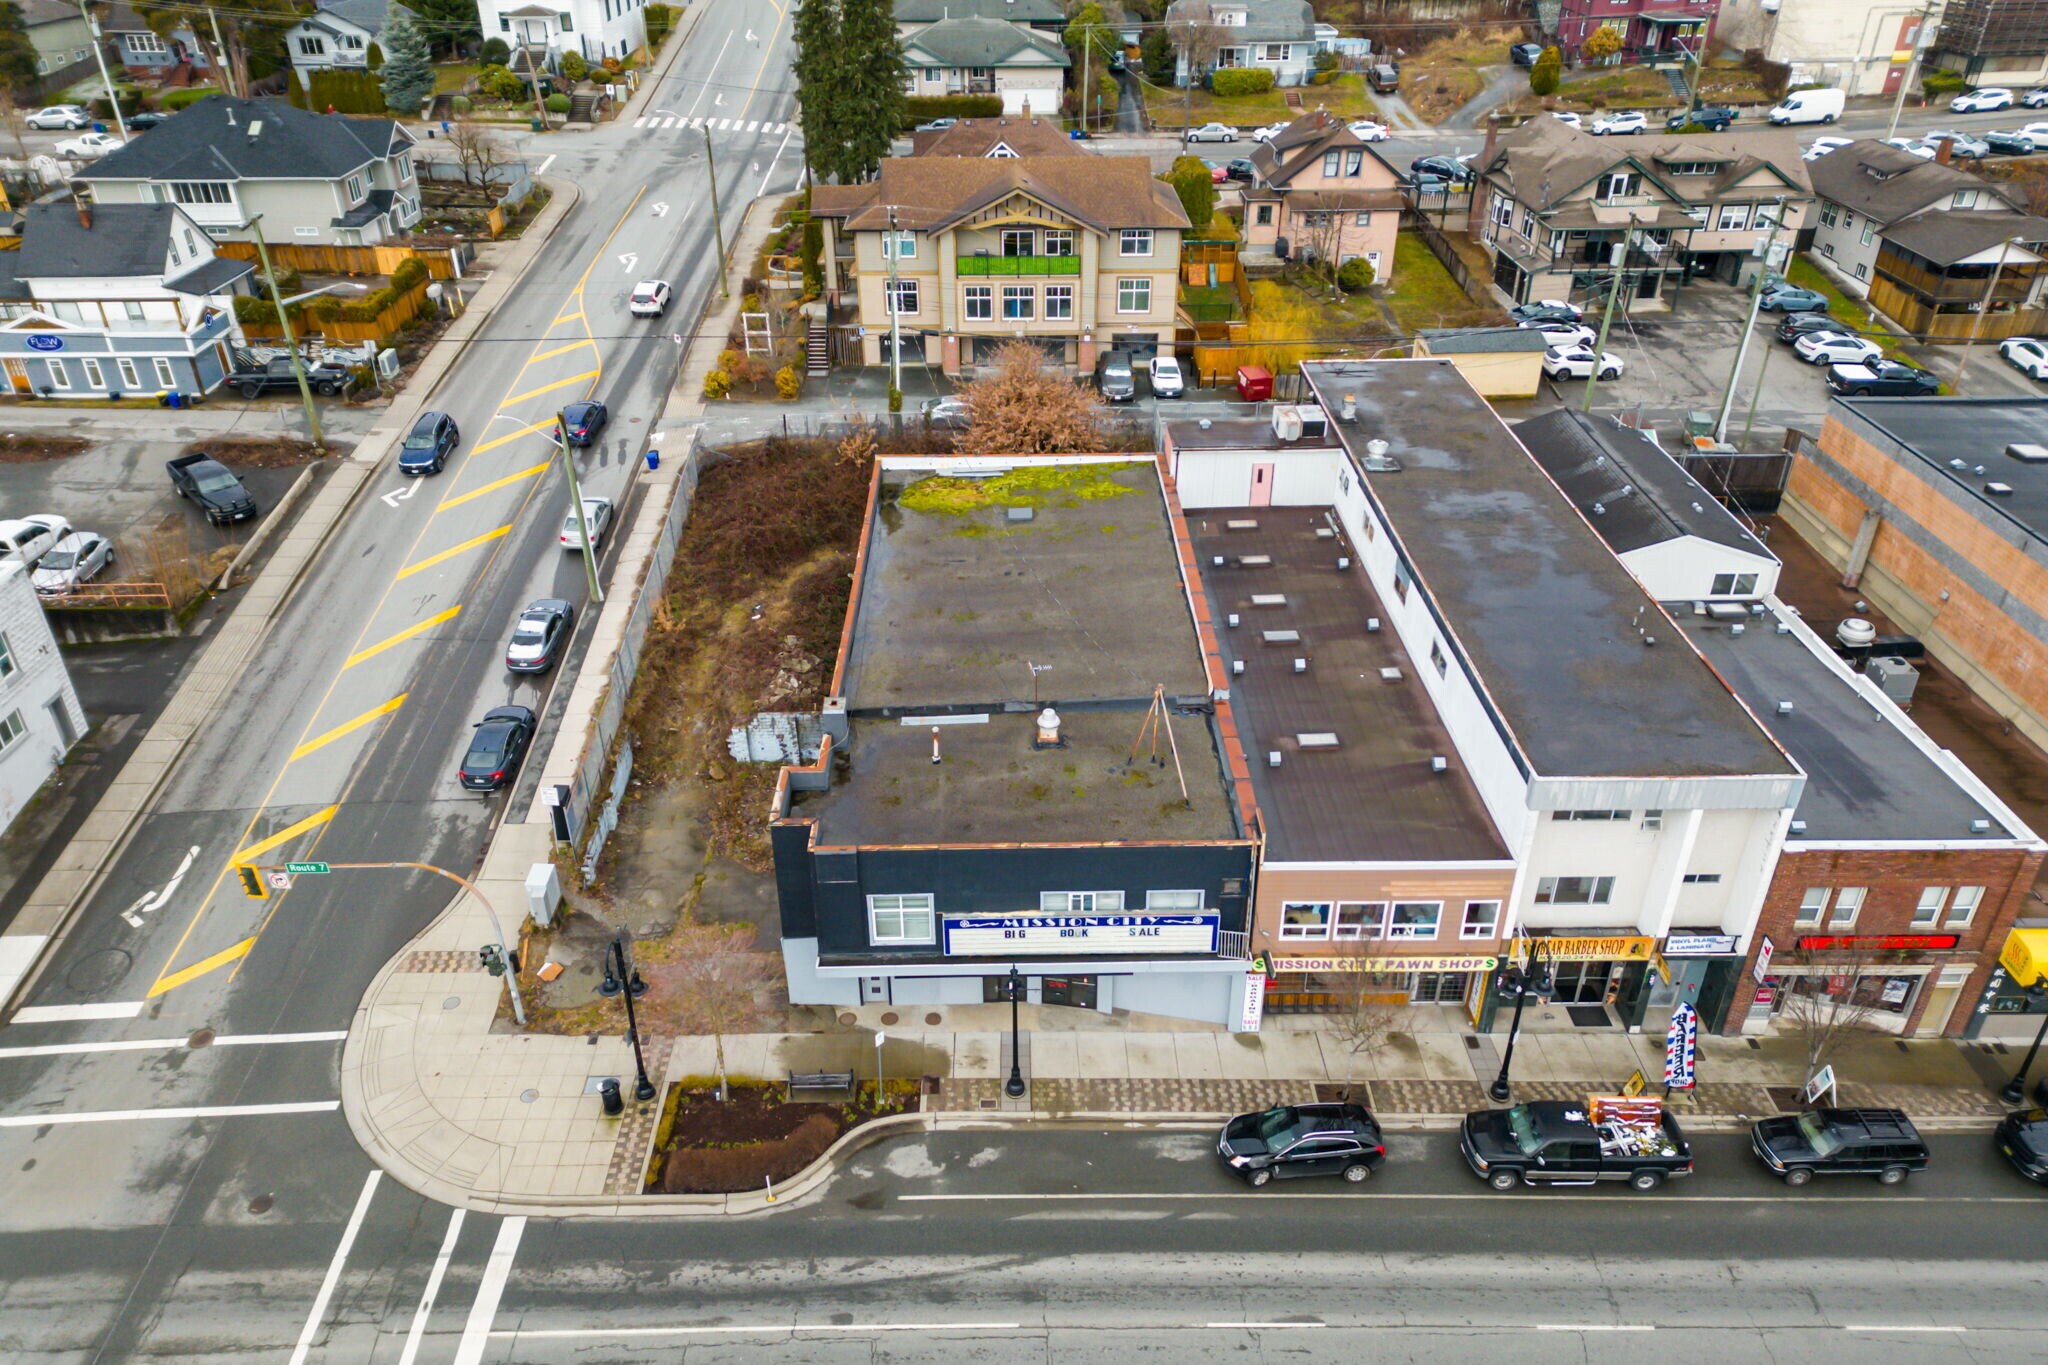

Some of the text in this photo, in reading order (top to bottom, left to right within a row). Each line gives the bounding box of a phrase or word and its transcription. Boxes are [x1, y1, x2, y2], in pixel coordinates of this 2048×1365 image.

[289, 864, 317, 872] Route
[1002, 917, 1160, 928] MISSION CITY
[1004, 927, 1160, 938] BIG BOK SALE
[1564, 940, 1598, 955] BARBER
[1599, 939, 1626, 955] SHOP
[1337, 960, 1379, 969] CITY
[1385, 960, 1434, 969] PAWN
[1439, 960, 1483, 969] SHOP
